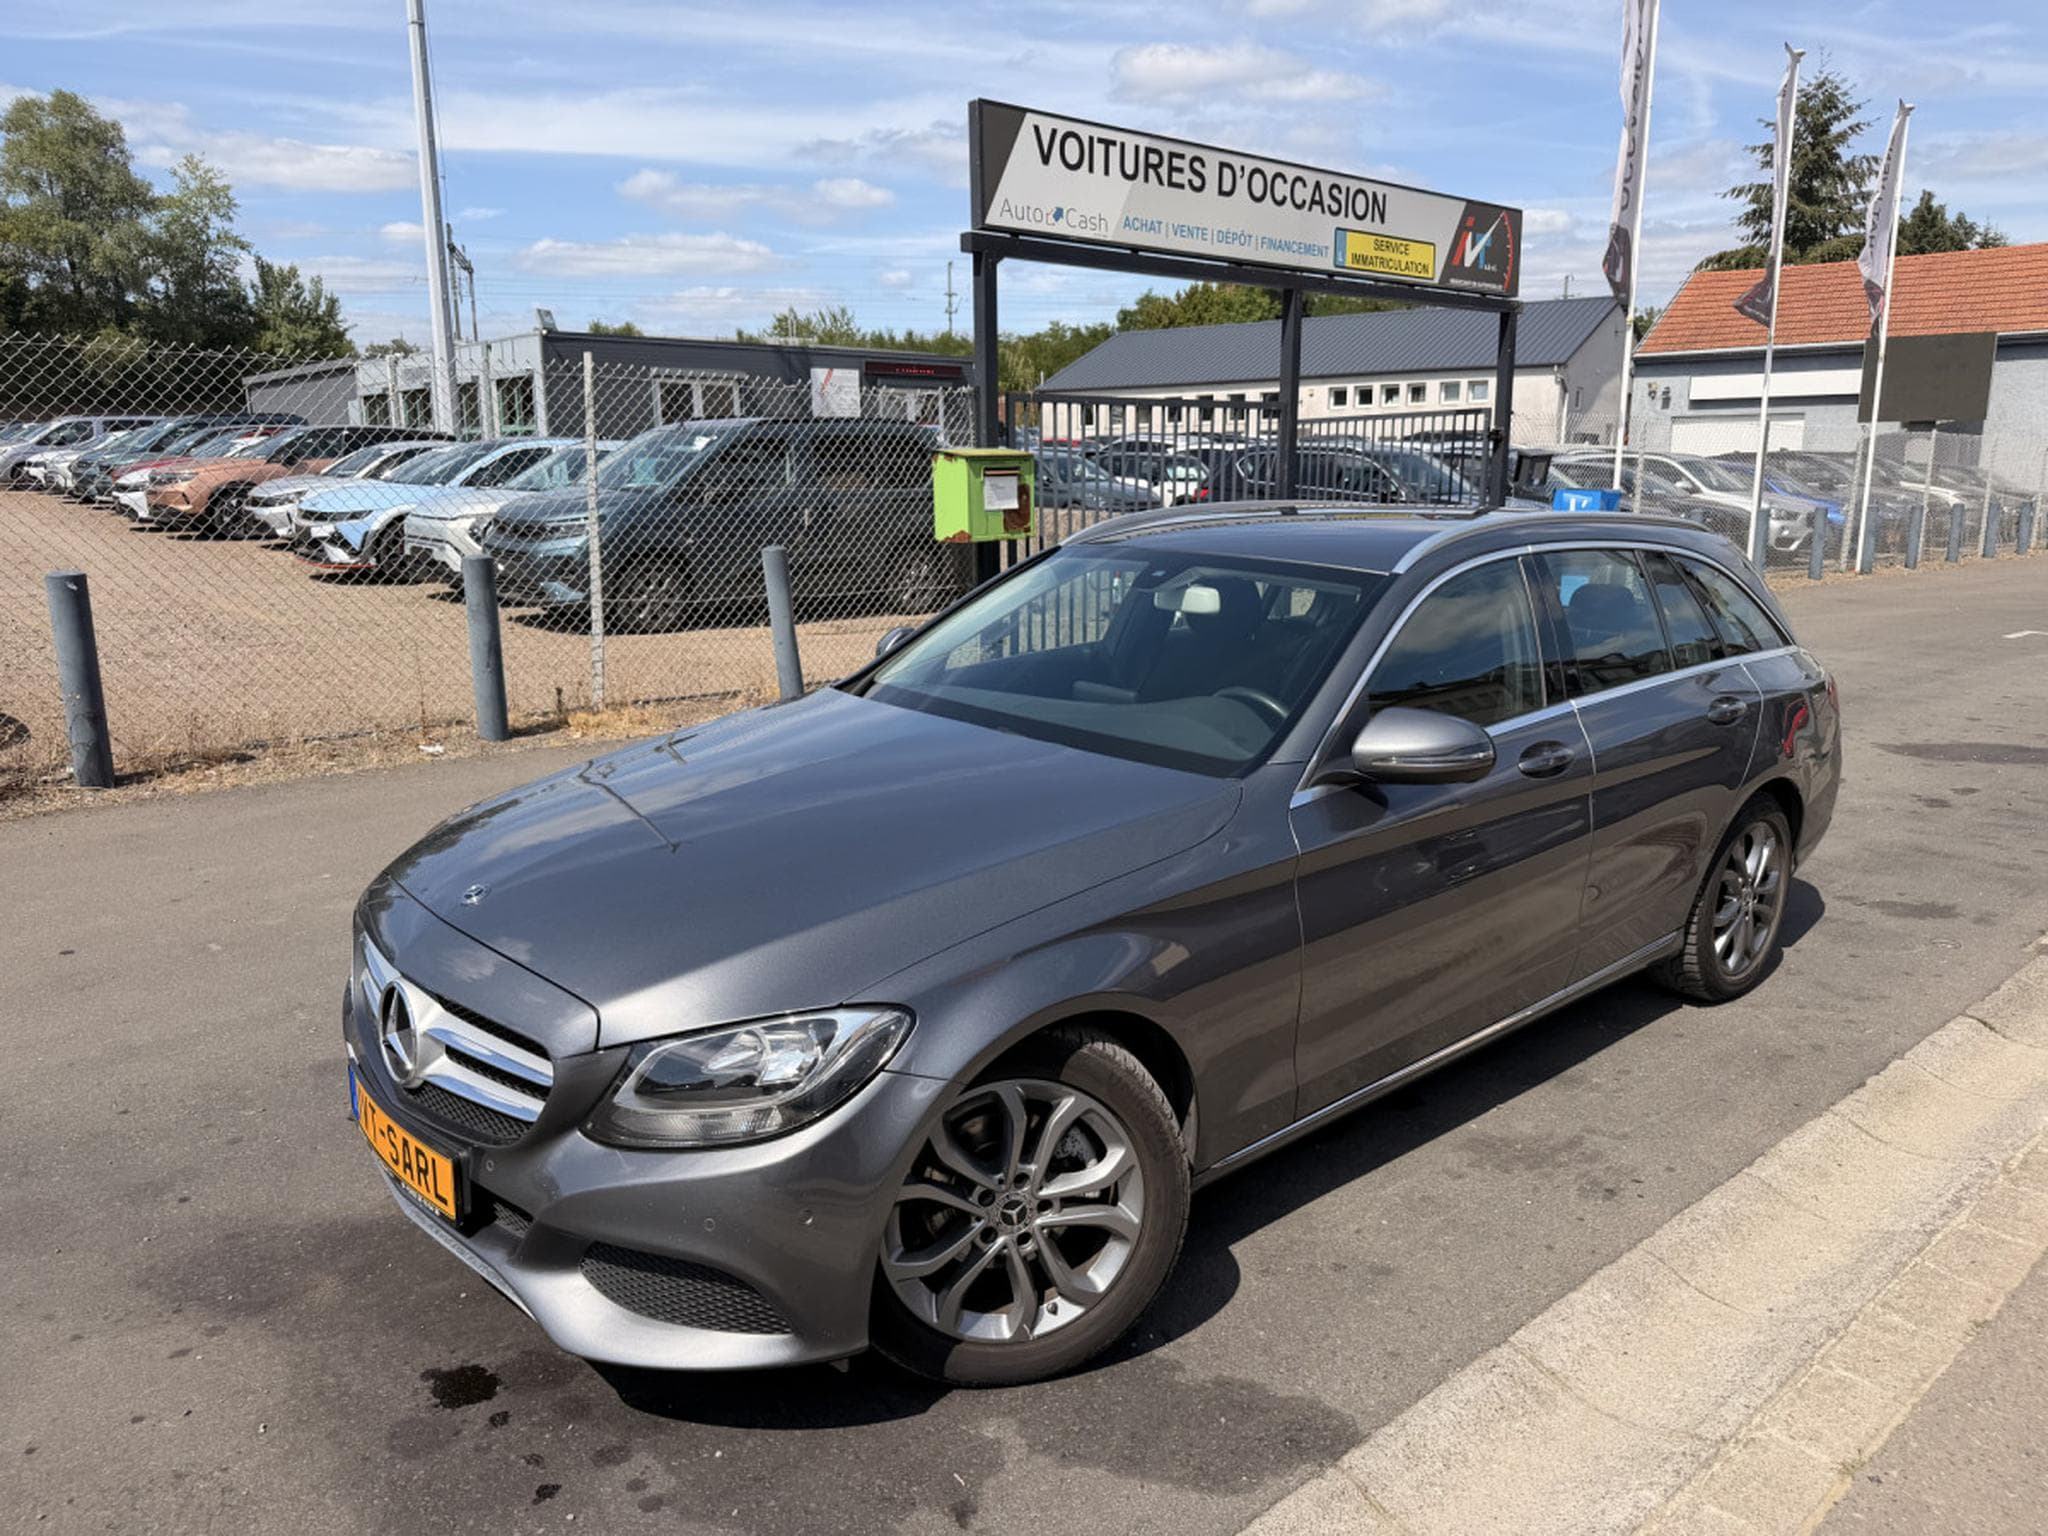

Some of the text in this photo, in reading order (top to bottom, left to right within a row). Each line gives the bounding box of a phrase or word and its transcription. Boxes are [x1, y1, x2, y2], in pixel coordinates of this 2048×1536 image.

[1032, 124, 1388, 225] VOITURES D'OCCASION
[1000, 197, 1109, 233] Auto Cash
[1122, 215, 1163, 234] ACHAT
[1171, 223, 1209, 242] VENTE
[1216, 227, 1253, 247] DÉPÔT
[1260, 236, 1330, 259] FINANCEMENT
[1372, 238, 1411, 256] SERVICE
[1350, 252, 1431, 275] IMMATRICULATION
